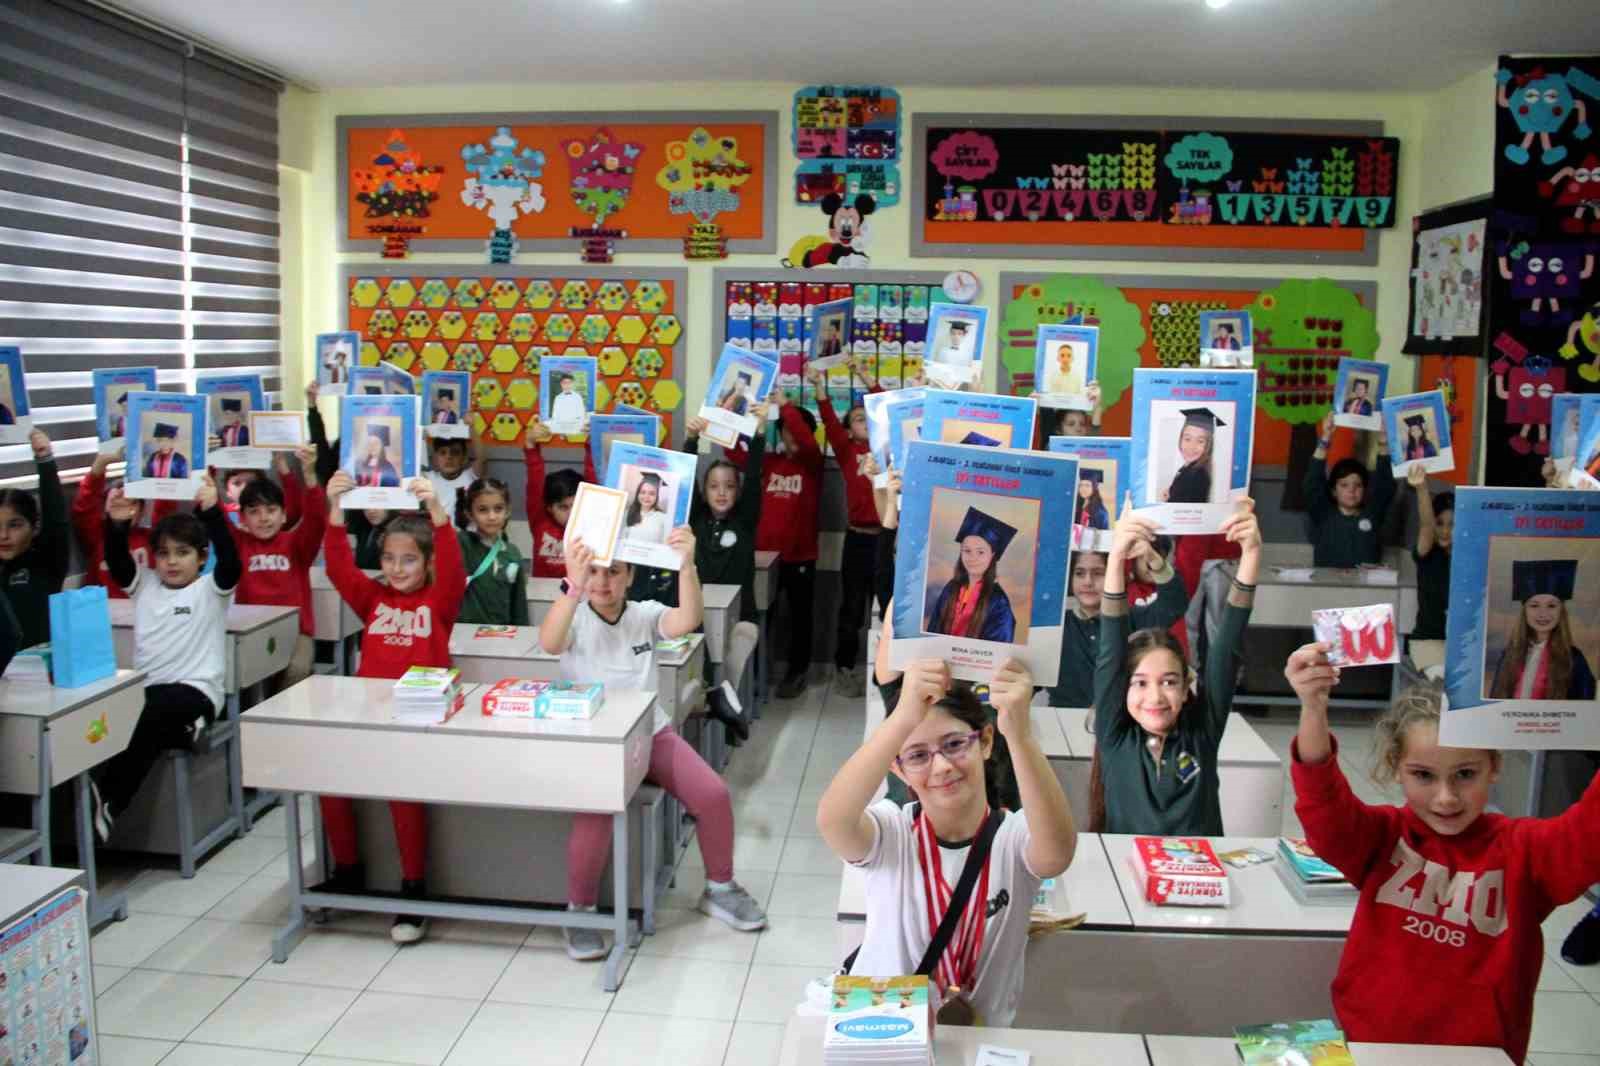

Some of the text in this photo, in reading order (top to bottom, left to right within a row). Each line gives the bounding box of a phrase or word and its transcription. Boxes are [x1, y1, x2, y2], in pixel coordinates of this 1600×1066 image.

[1189, 149, 1210, 159] TEK
[1177, 160, 1221, 170] SAYILAR
[992, 191, 1147, 212] 0 2 4 6 8
[1226, 196, 1379, 218] 1 3 5 7 9
[696, 225, 715, 234] YAZ
[248, 554, 290, 572] ZMO
[368, 602, 432, 639] ZMO
[1376, 837, 1508, 937] ZMO
[1402, 916, 1466, 947] 2008
